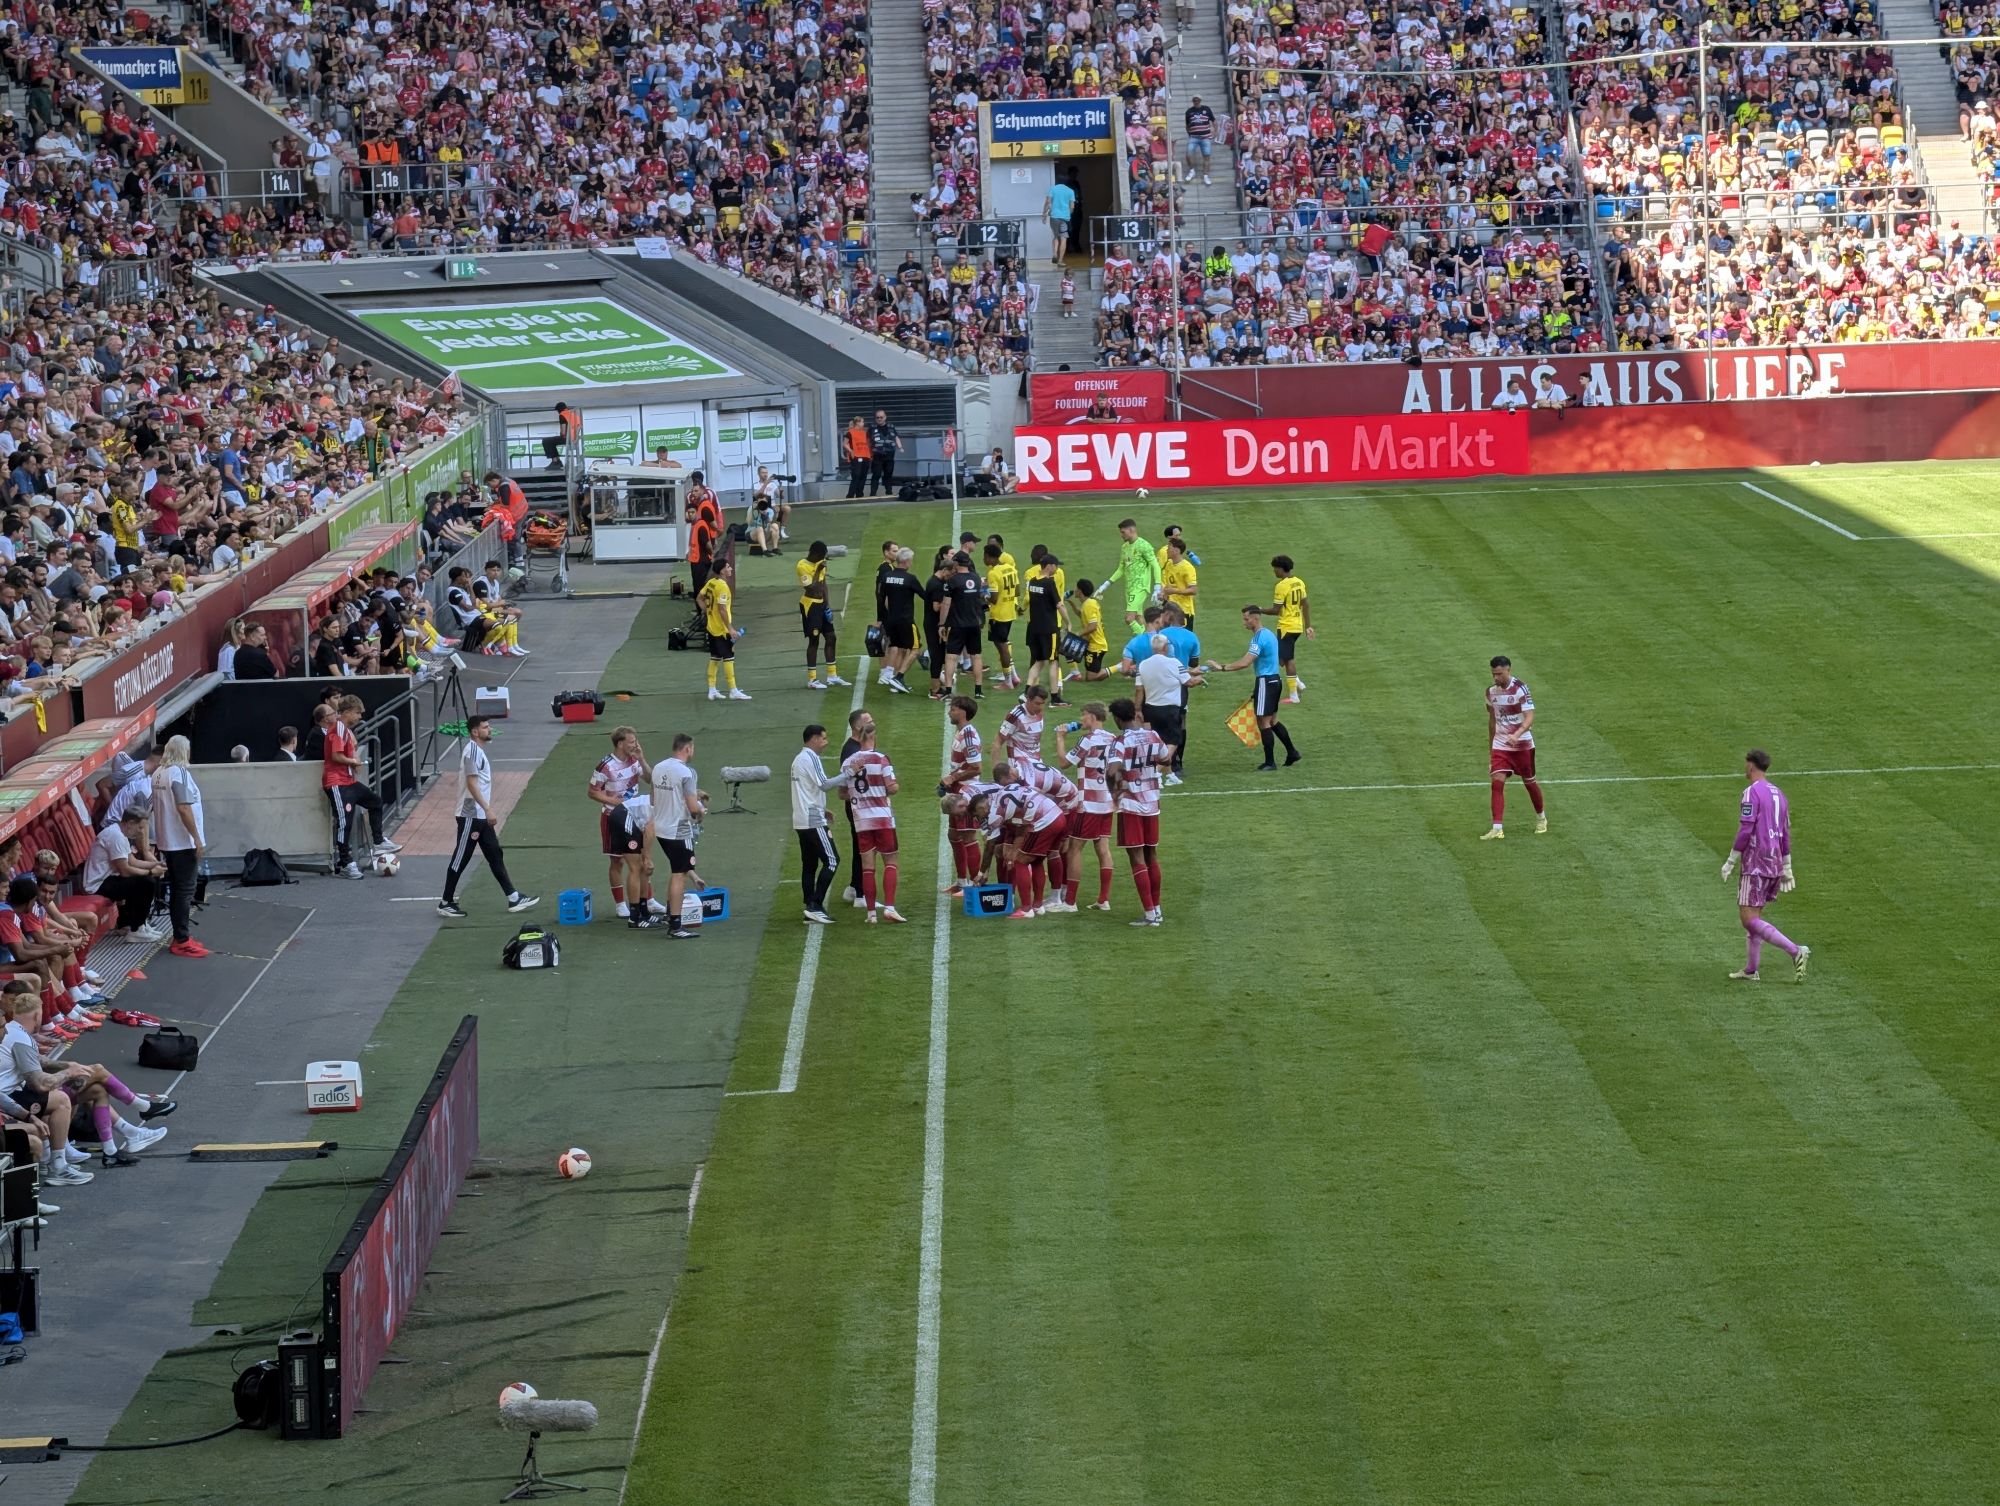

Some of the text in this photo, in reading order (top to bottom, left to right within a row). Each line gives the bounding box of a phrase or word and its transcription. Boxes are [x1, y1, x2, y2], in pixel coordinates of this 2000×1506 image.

[158, 59, 177, 77] Alt
[995, 109, 1106, 131] Schumacher Alt
[1007, 142, 1024, 157] 12
[1080, 139, 1096, 154] 13
[271, 174, 291, 191] 11A
[381, 170, 399, 188] 11B
[980, 225, 998, 242] 12
[1122, 221, 1140, 238] 13
[401, 309, 601, 332] Energie in
[423, 326, 643, 353] jeder Ecke.
[1074, 379, 1119, 391] OFFENSIVE
[1587, 360, 1684, 407] AUS
[1055, 396, 1148, 409] FORTUNA SSELDORF
[648, 433, 681, 441] STADTWERKE
[1014, 422, 1496, 484] REWE Dein Markt
[114, 641, 174, 715] FORTUNA DÜSSELDORF
[1130, 743, 1157, 774] 44
[854, 766, 870, 794] 8
[1772, 795, 1780, 827] 1
[702, 898, 722, 907] POWER
[520, 950, 542, 958] radios
[313, 1089, 350, 1103] radios
